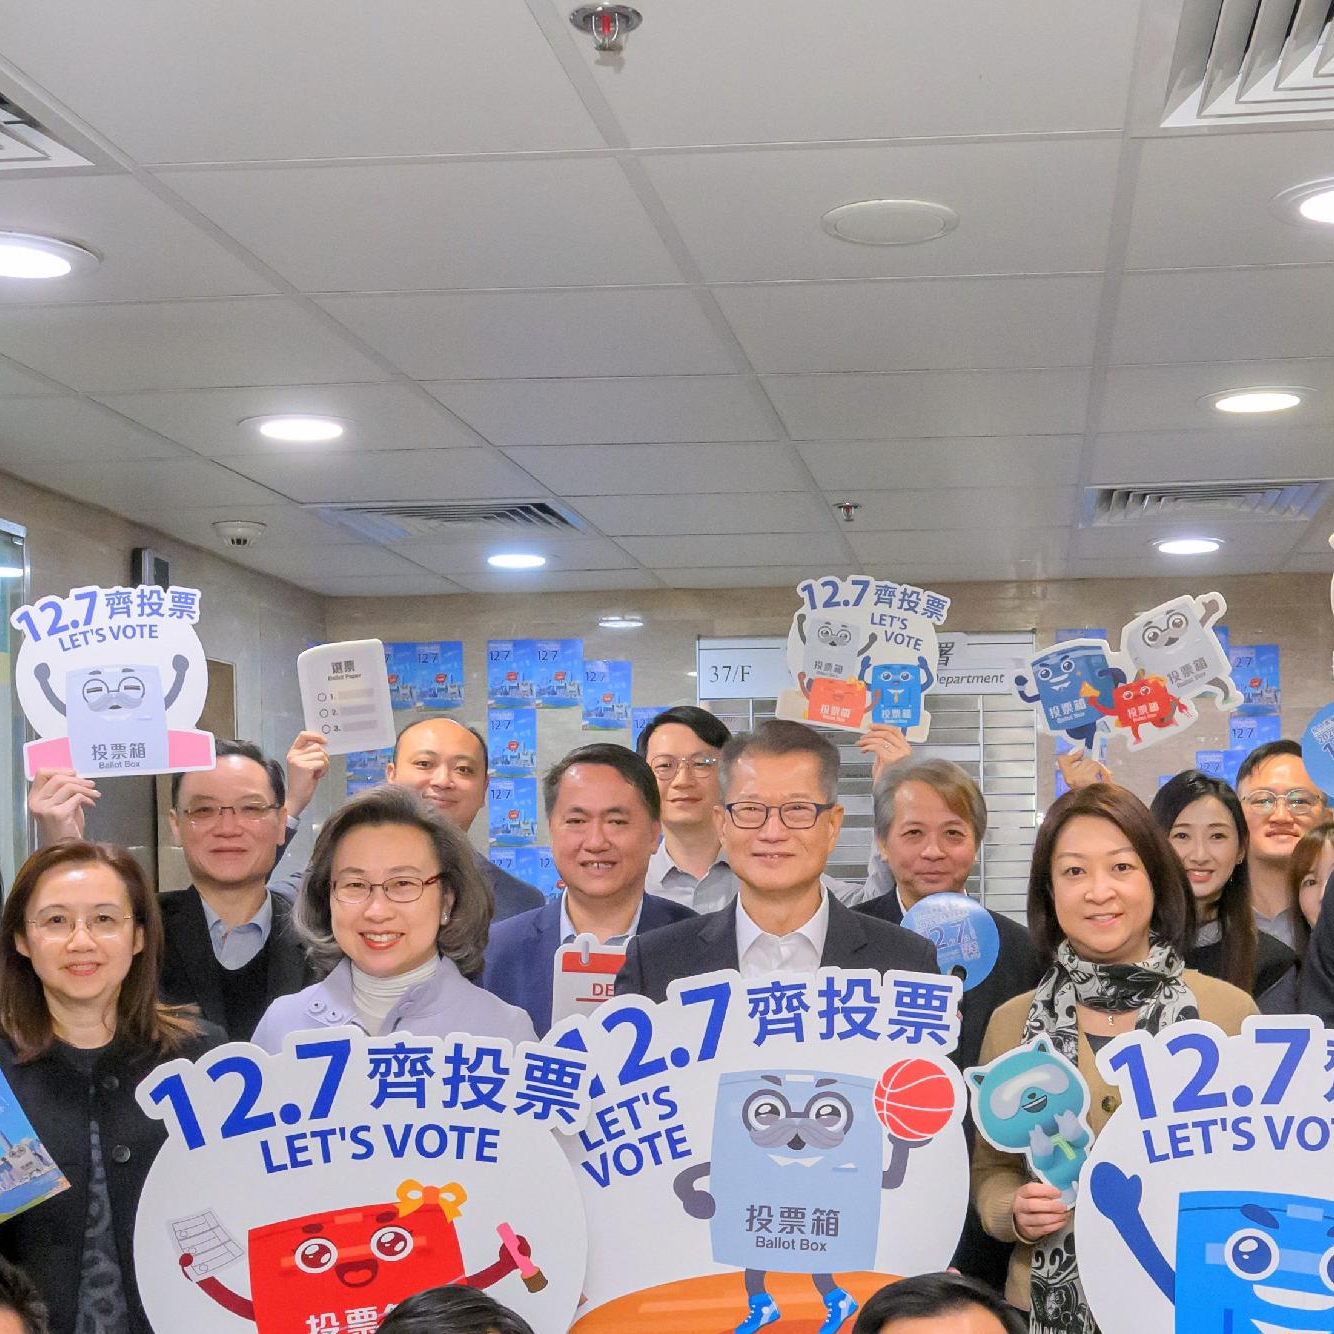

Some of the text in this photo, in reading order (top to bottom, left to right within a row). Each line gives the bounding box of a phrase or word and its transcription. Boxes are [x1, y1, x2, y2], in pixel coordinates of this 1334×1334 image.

[17, 590, 98, 643] 12.7
[104, 588, 198, 620] 齊投票
[800, 578, 949, 622] 12.7 齊投票
[58, 624, 159, 652] LET'S VOTE
[870, 612, 909, 630] LET'S
[884, 630, 924, 652] VOTE
[709, 664, 752, 684] 37/F
[936, 673, 1005, 688] epartment
[91, 742, 146, 761] 投票箱
[98, 760, 141, 770] Ballot Box
[592, 983, 615, 997] DE
[746, 976, 954, 1047] 齊投票
[1109, 1027, 1311, 1121] 12.7
[148, 1038, 587, 1151] 12.7 齊投票
[579, 1084, 678, 1152] LET'S
[260, 1123, 501, 1175] LET'S VOTE
[582, 1123, 693, 1189] VOTE
[1142, 1115, 1257, 1165] LET'S
[745, 1203, 841, 1238] 投票箱
[755, 1235, 828, 1253] Ballot Box
